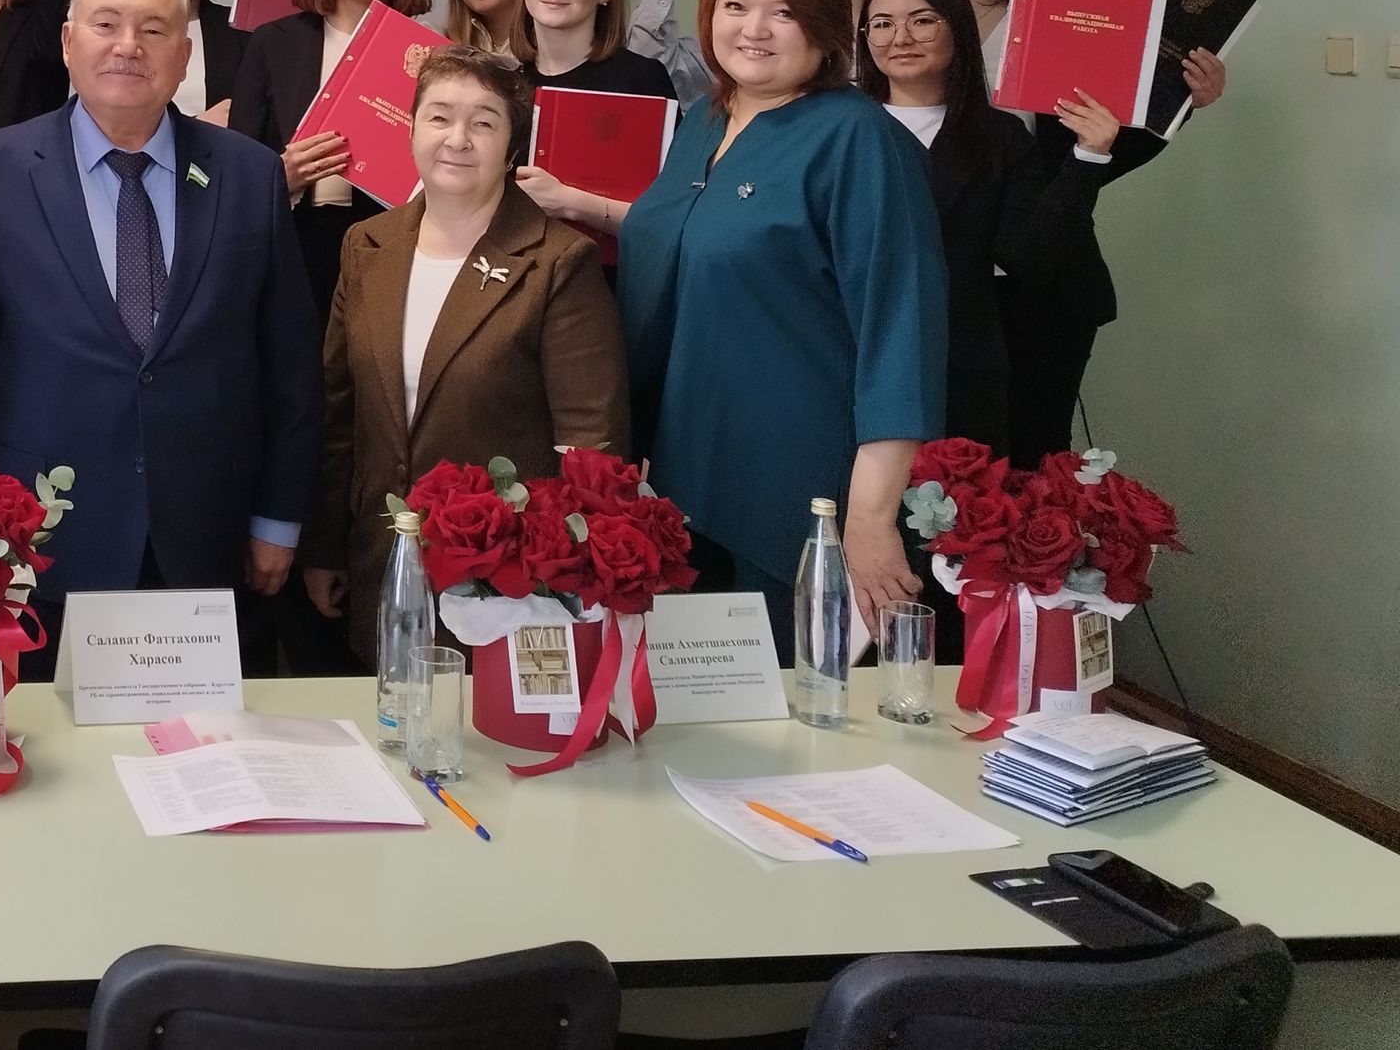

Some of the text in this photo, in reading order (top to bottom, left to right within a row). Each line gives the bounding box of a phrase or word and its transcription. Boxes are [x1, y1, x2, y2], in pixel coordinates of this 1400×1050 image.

[1066, 10, 1110, 21] ВЫПУСКНАЯ
[1072, 25, 1098, 34] РАБОТА
[87, 633, 221, 646] Салават Фаттахович
[678, 638, 761, 650] Ахметшаеховна
[129, 653, 182, 668] Харасов
[659, 654, 735, 667] Салимгареева
